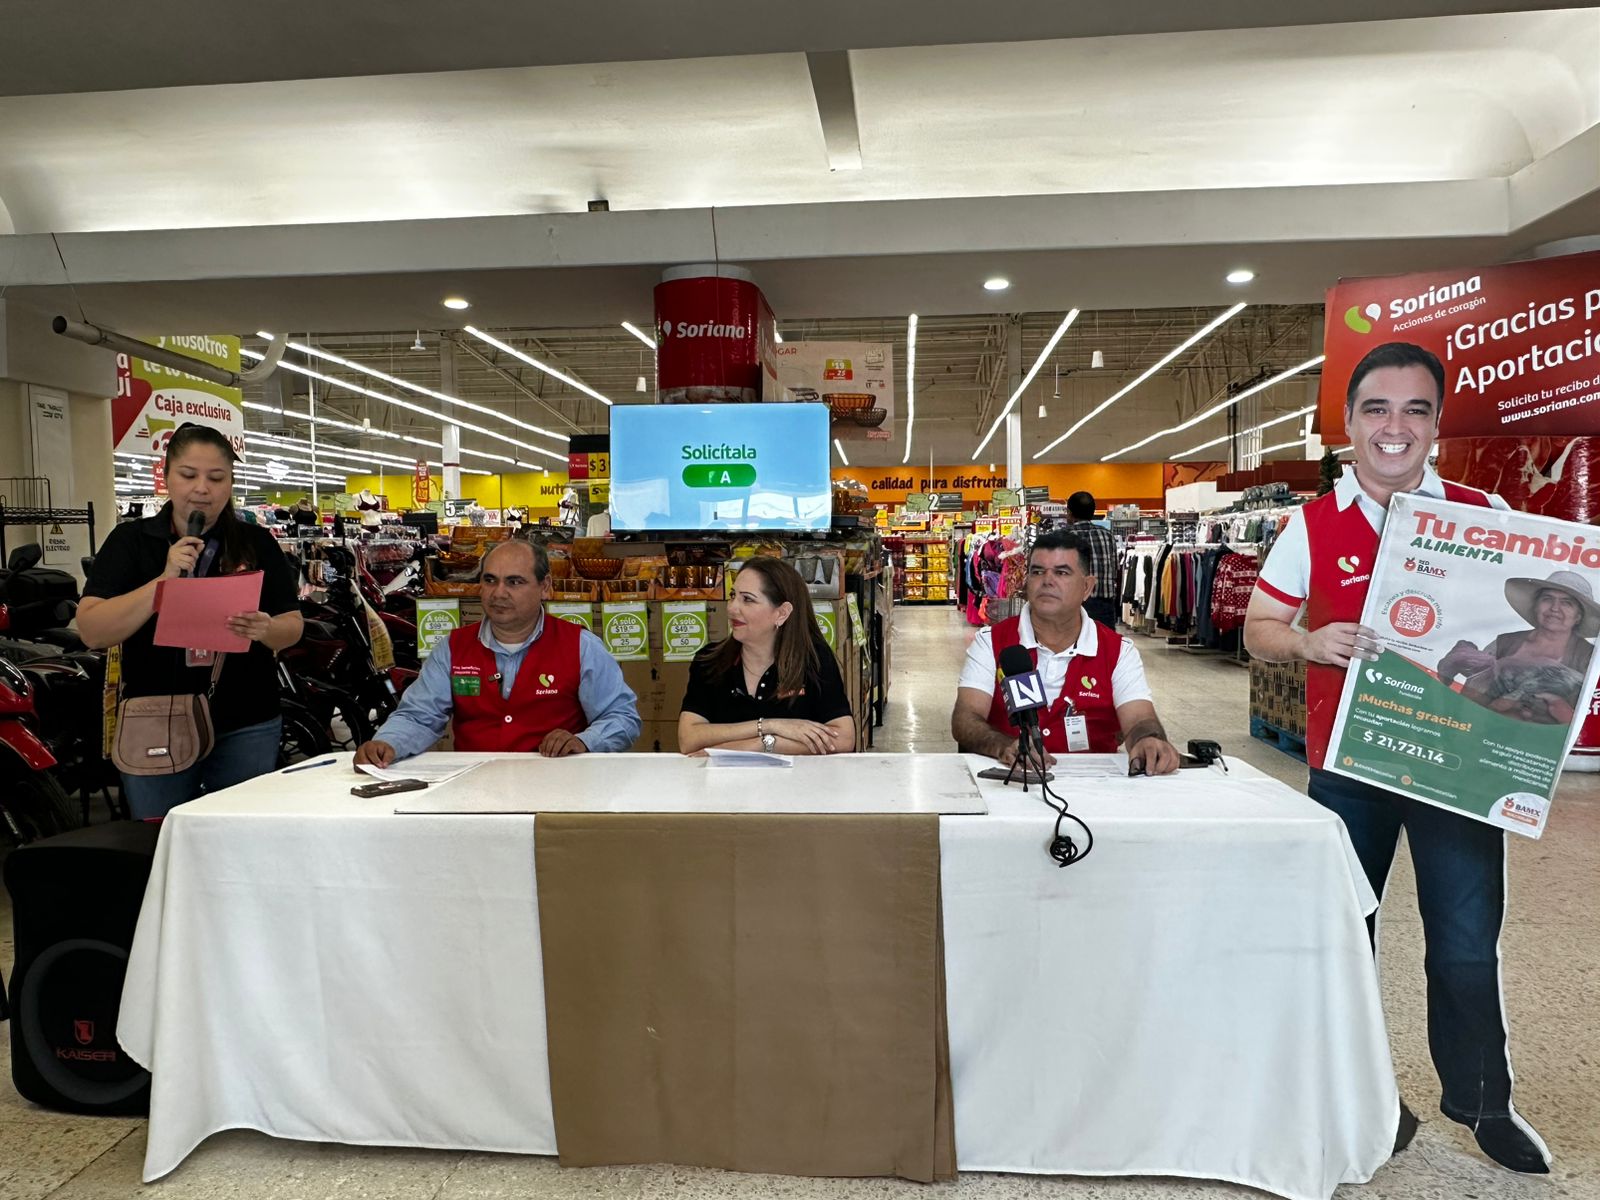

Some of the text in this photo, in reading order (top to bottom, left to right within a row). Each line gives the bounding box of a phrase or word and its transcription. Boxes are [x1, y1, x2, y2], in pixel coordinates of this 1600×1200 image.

[1390, 276, 1480, 318] Soriana
[1393, 297, 1486, 332] Acciones de corazón
[676, 320, 744, 338] Soriana
[1446, 298, 1575, 360] ¡Gracias
[172, 335, 228, 359] nosotros
[1498, 395, 1538, 411] Solicita
[1541, 388, 1552, 400] tu
[1556, 379, 1590, 396] recibo
[155, 394, 232, 422] Caja exclusiva
[682, 443, 756, 460] Solicítala
[872, 476, 913, 490] calidad
[921, 478, 948, 492] para
[928, 493, 940, 510] 2
[1015, 488, 1026, 506] 1
[445, 501, 456, 517] 5
[1413, 511, 1600, 568] Tu cambio
[1410, 536, 1504, 564] ALIMENTA
[1417, 565, 1446, 576] BAMX
[1340, 574, 1370, 586] Soriana
[620, 616, 636, 625] sólo
[680, 638, 690, 646] 50
[536, 688, 558, 696] Soriana
[1079, 690, 1100, 698] Soriana
[1384, 676, 1424, 694] Soriana
[1358, 693, 1472, 732] ¡Muchas gracias!
[1363, 729, 1445, 764] $ 21,721.14
[1515, 804, 1540, 817] BAMX
[56, 1048, 116, 1062] KAISER
